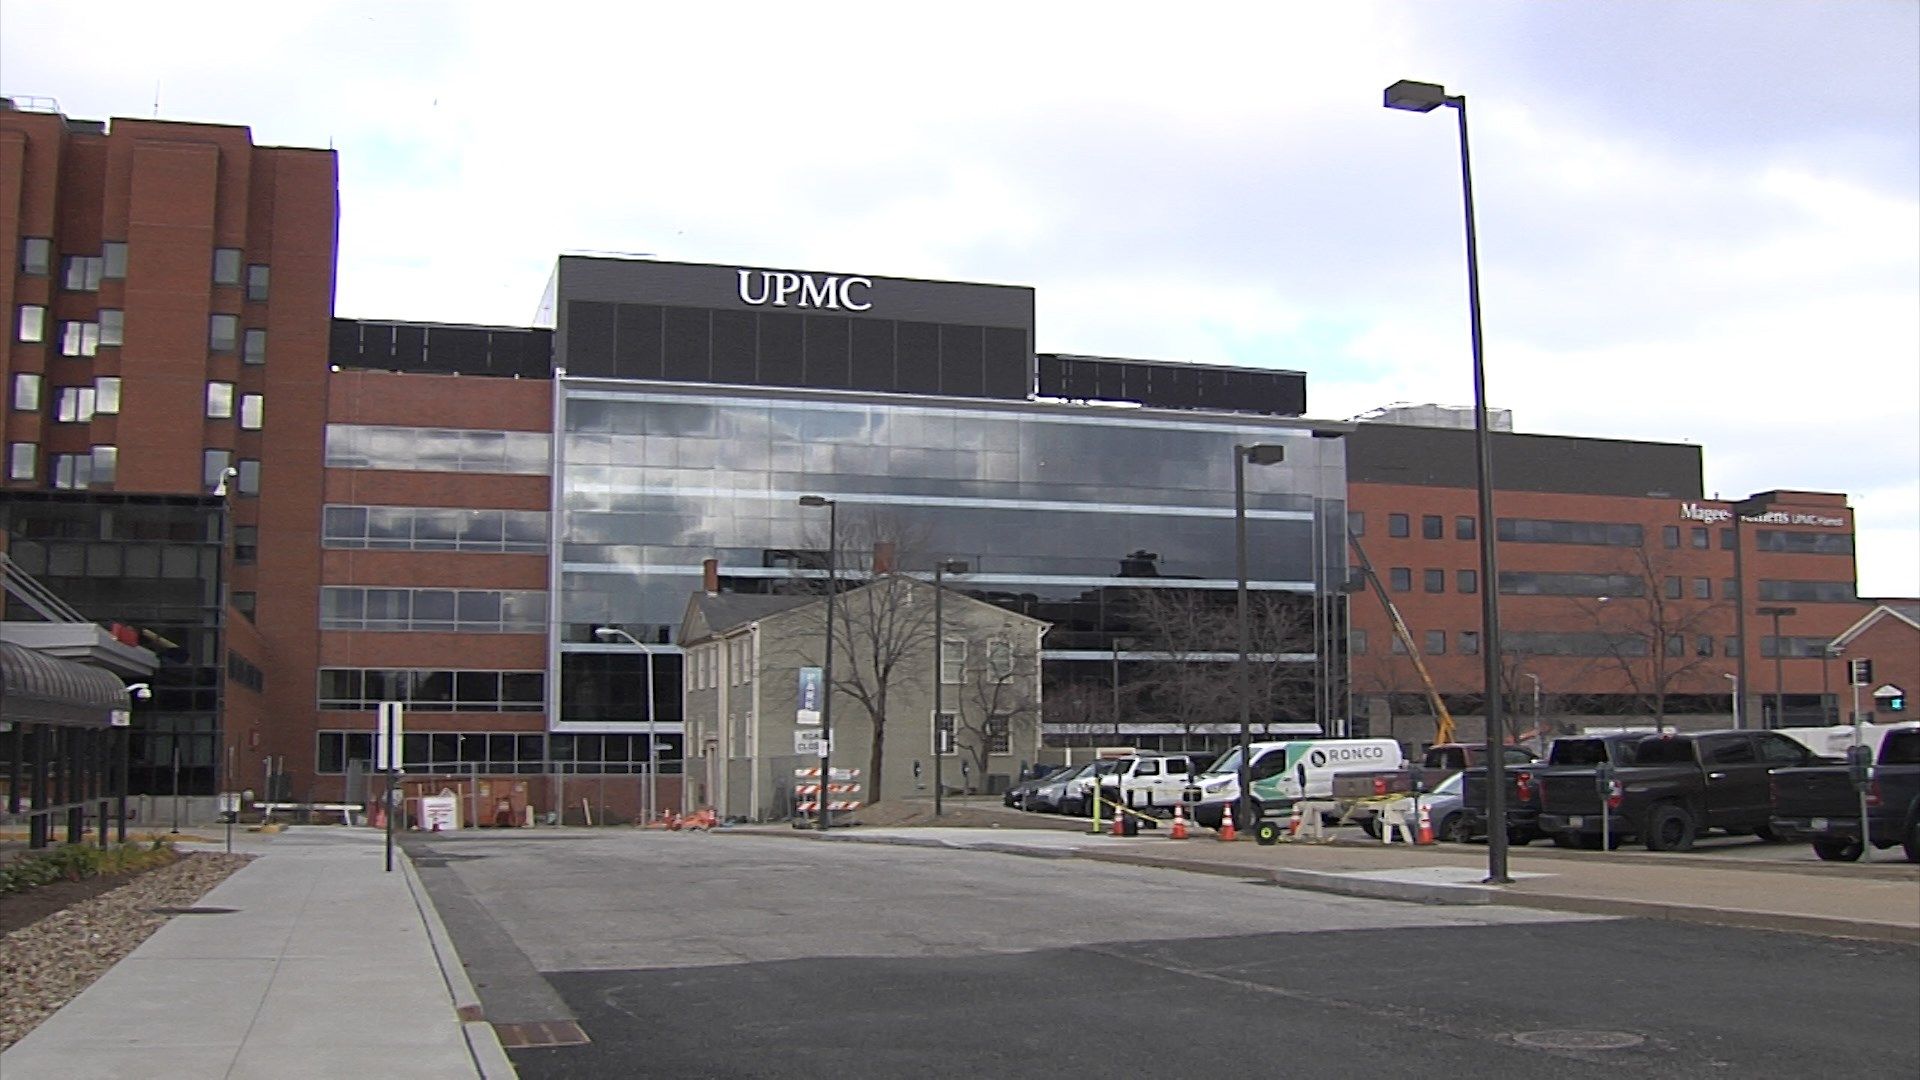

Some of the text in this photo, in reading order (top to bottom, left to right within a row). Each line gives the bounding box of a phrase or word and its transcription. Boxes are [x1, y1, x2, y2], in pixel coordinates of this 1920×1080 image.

[737, 270, 872, 311] UPMC
[797, 742, 820, 750] CLOS
[1329, 746, 1383, 760] RONCO
